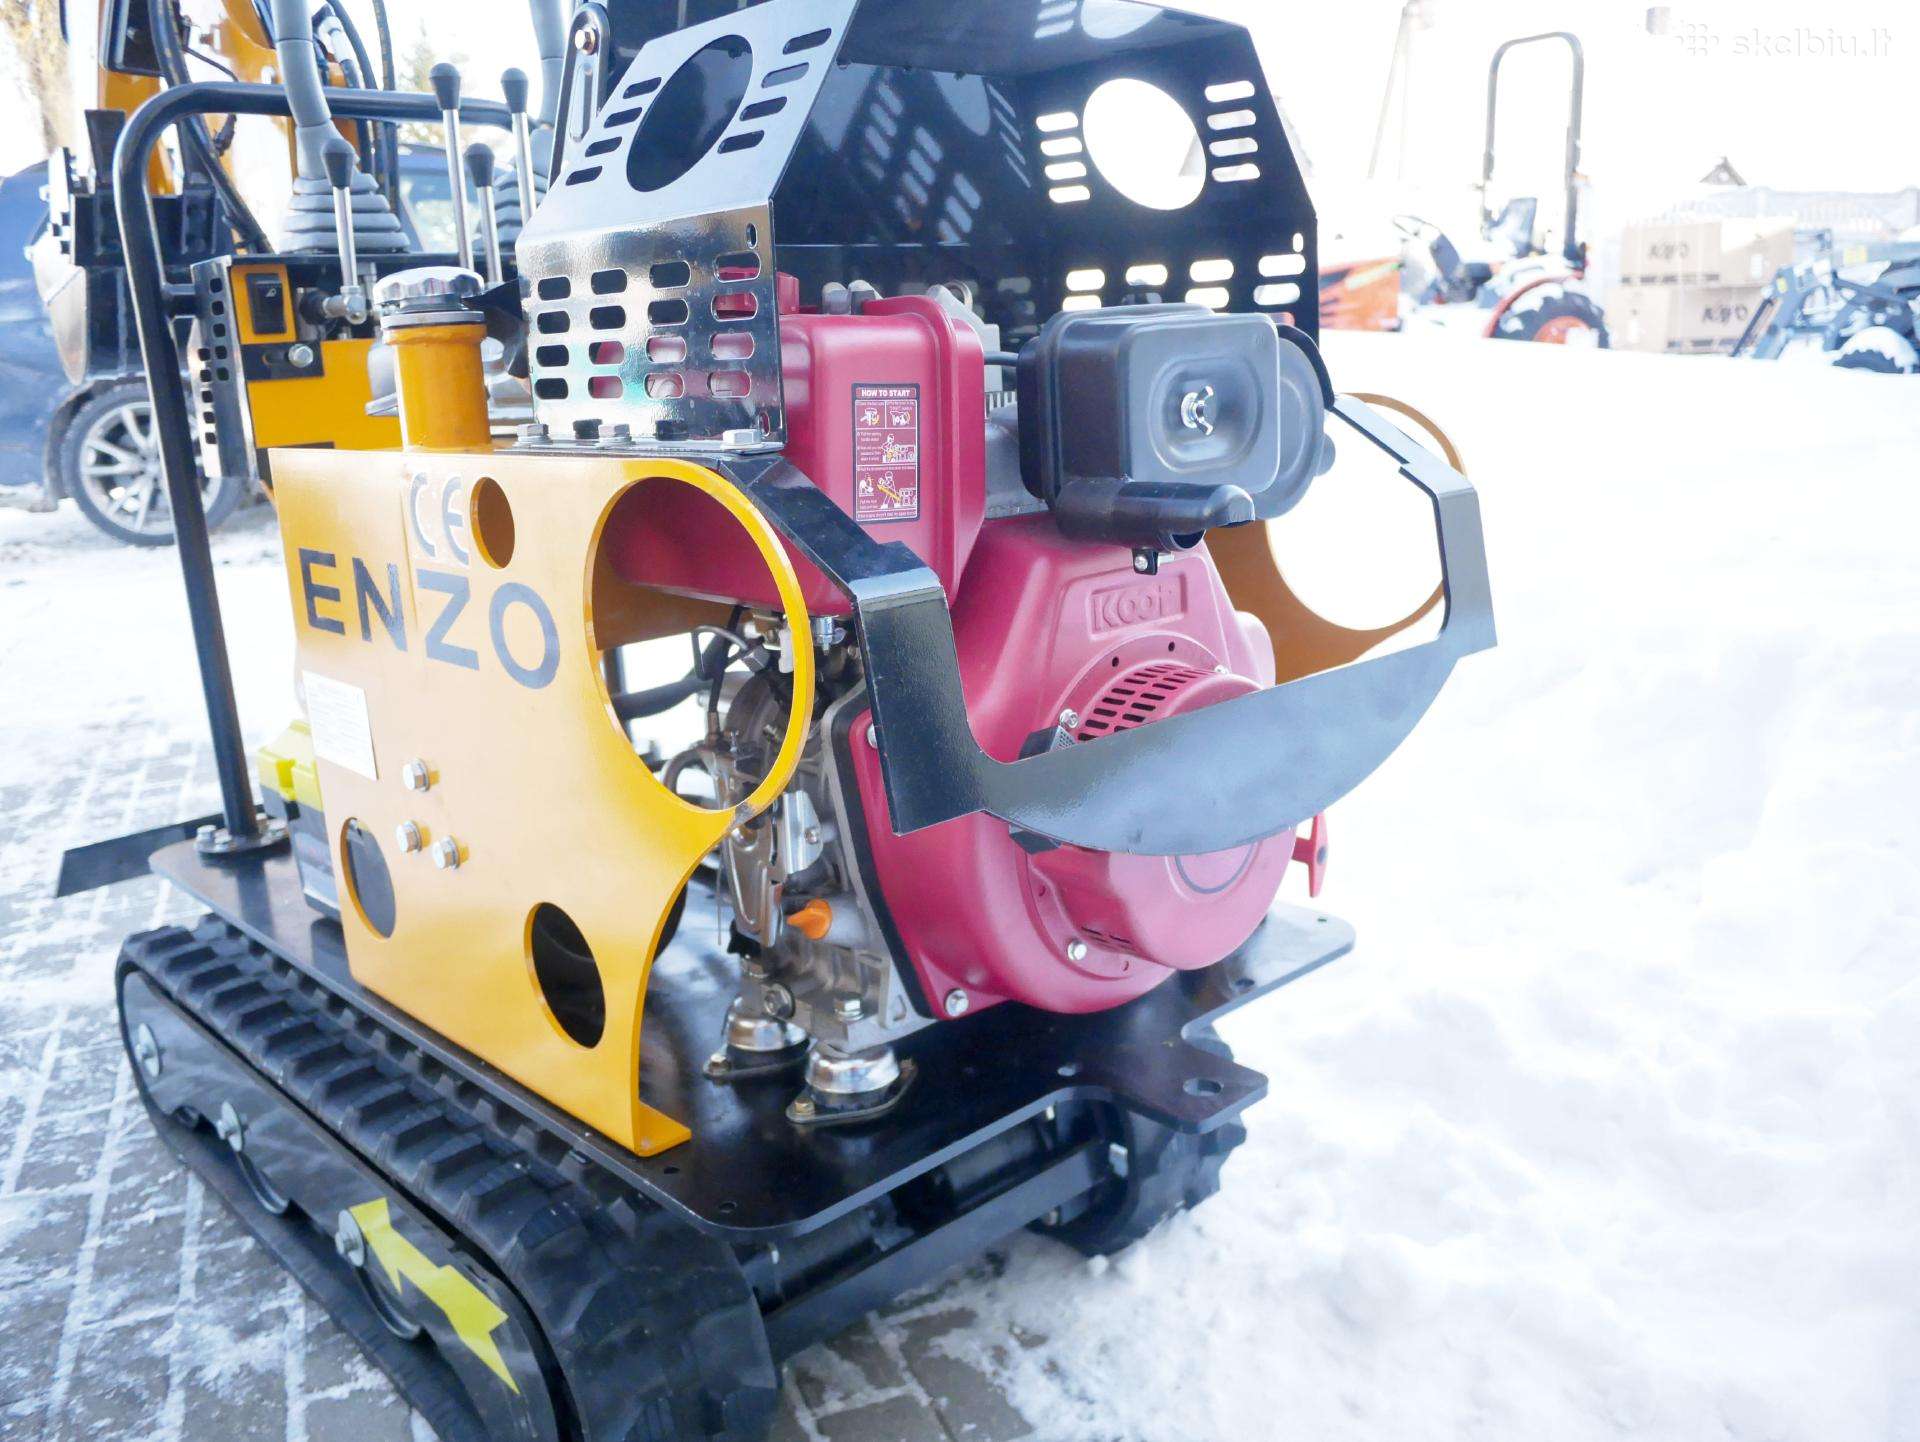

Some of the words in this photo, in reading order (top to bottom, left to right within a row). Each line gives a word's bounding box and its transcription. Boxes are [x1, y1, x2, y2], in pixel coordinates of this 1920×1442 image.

[861, 389, 878, 397] HOW
[879, 389, 888, 397] TO
[889, 389, 910, 397] START
[298, 547, 561, 690] ENZO
